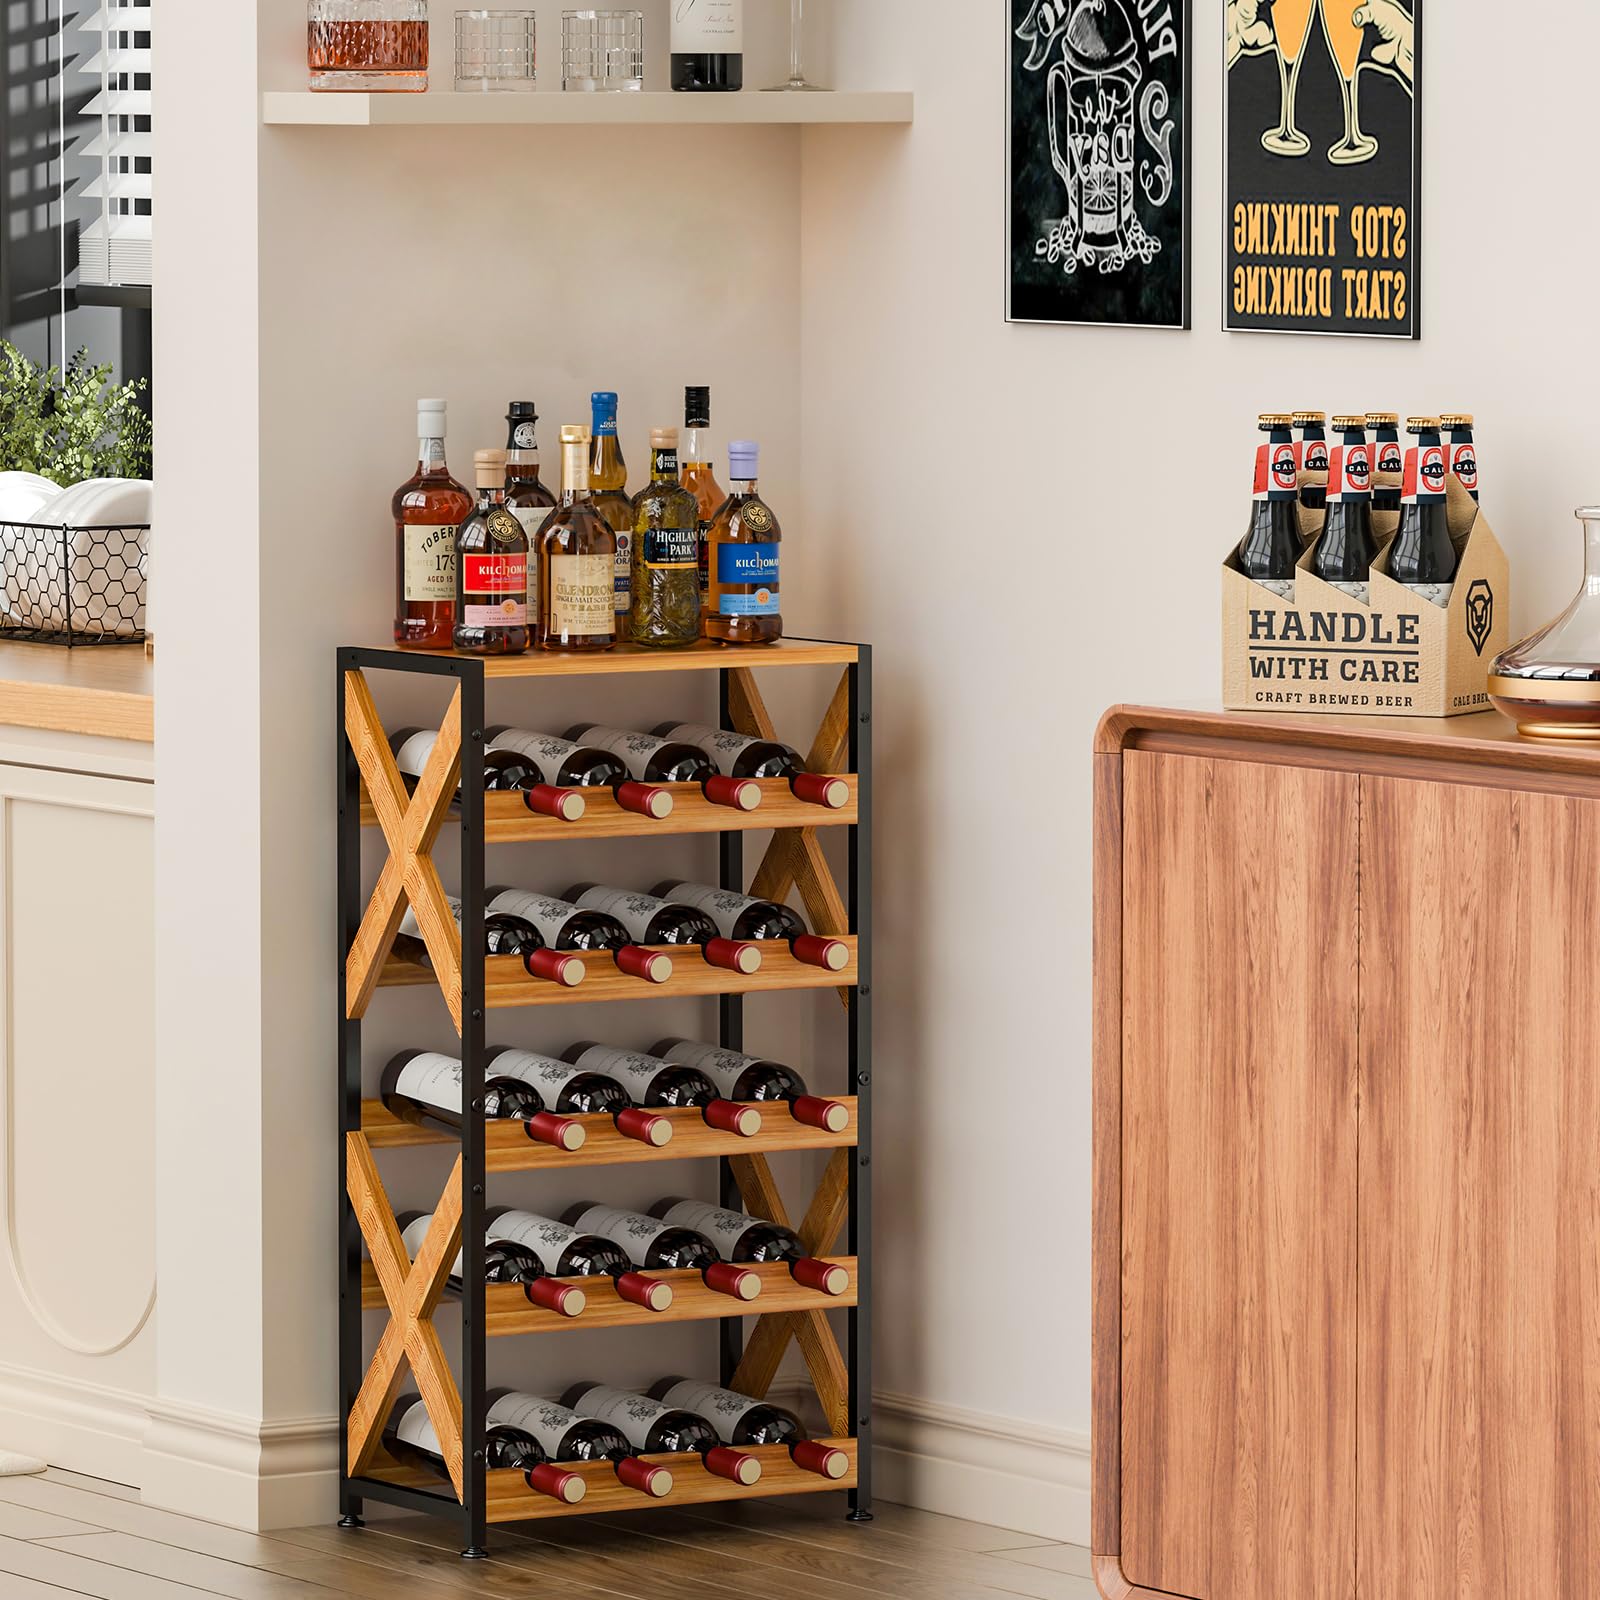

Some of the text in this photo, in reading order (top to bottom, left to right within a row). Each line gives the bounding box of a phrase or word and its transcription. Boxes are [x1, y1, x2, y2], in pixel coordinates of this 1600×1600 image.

[670, 544, 692, 555] PARK
[446, 575, 454, 583] 15
[1249, 609, 1419, 645] HANDLE
[1249, 656, 1419, 683] WITH CARE
[1255, 691, 1413, 707] CRAFT BREWED BEER
[1453, 694, 1471, 707] CALE
